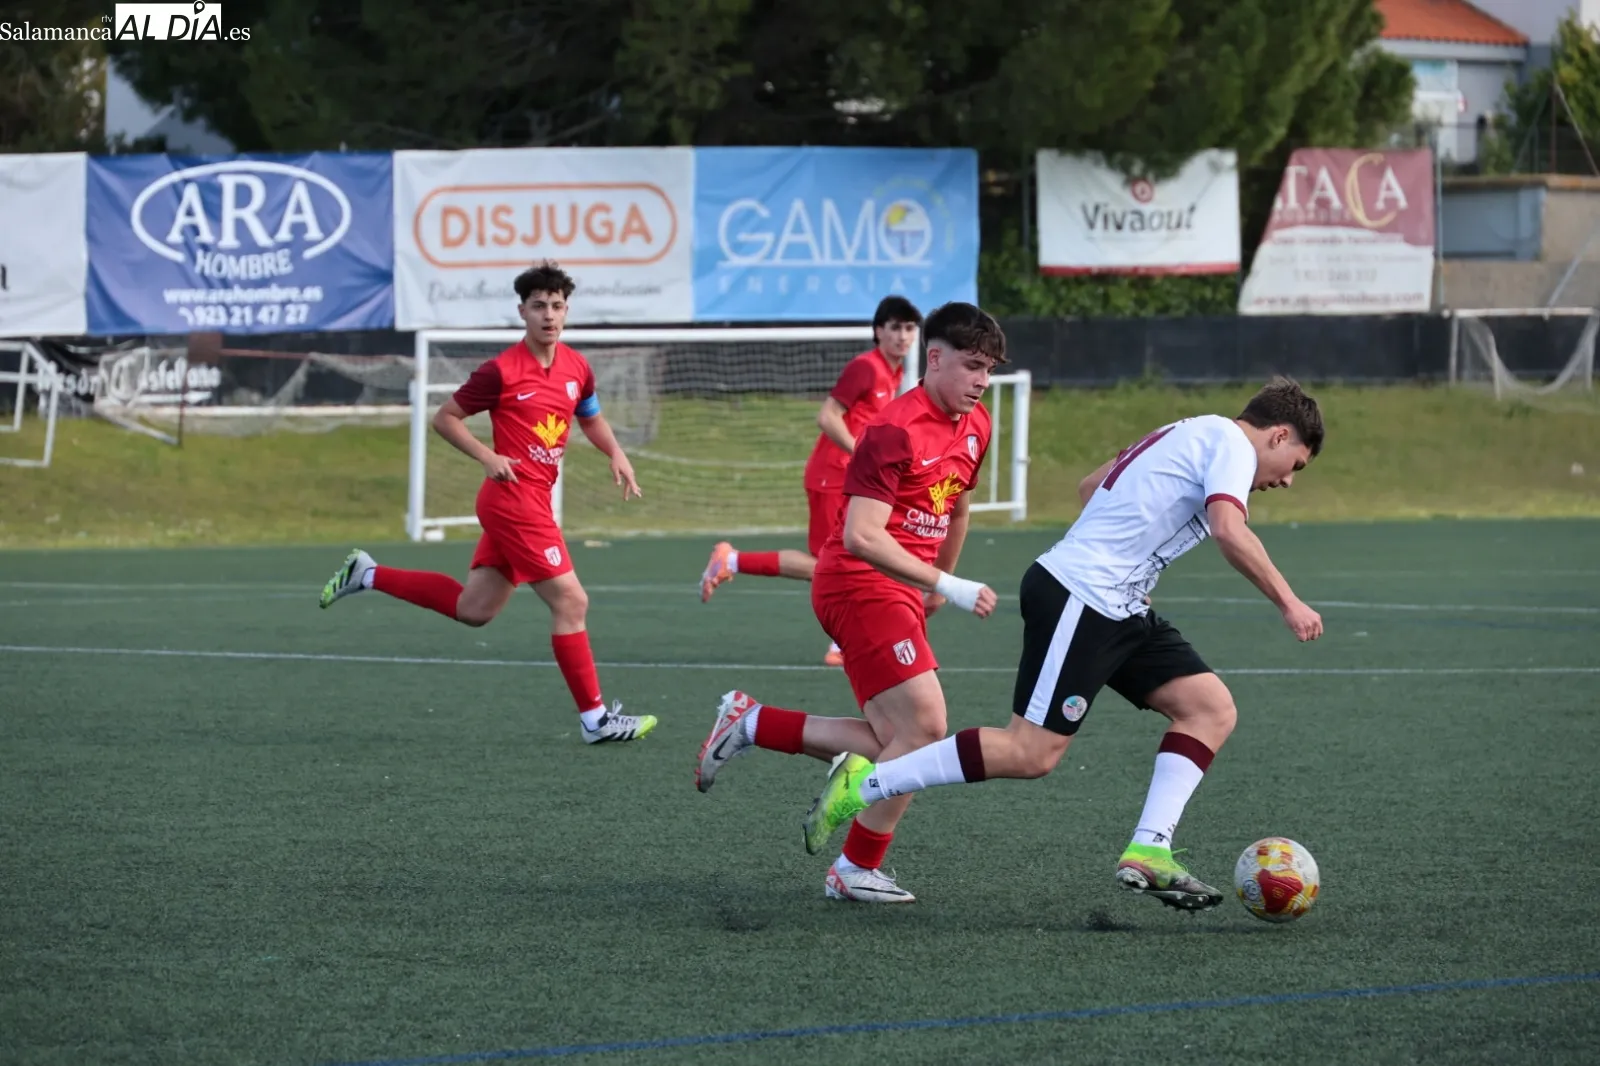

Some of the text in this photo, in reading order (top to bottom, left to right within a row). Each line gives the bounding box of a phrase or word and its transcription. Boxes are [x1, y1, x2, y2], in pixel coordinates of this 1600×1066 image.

[166, 173, 325, 249] ARA
[440, 202, 654, 248] DISJUGA
[718, 197, 932, 264] GAMO
[194, 249, 293, 281] HOMBRE
[228, 306, 252, 326] 21
[256, 304, 281, 325] 47
[284, 304, 309, 325] 27
